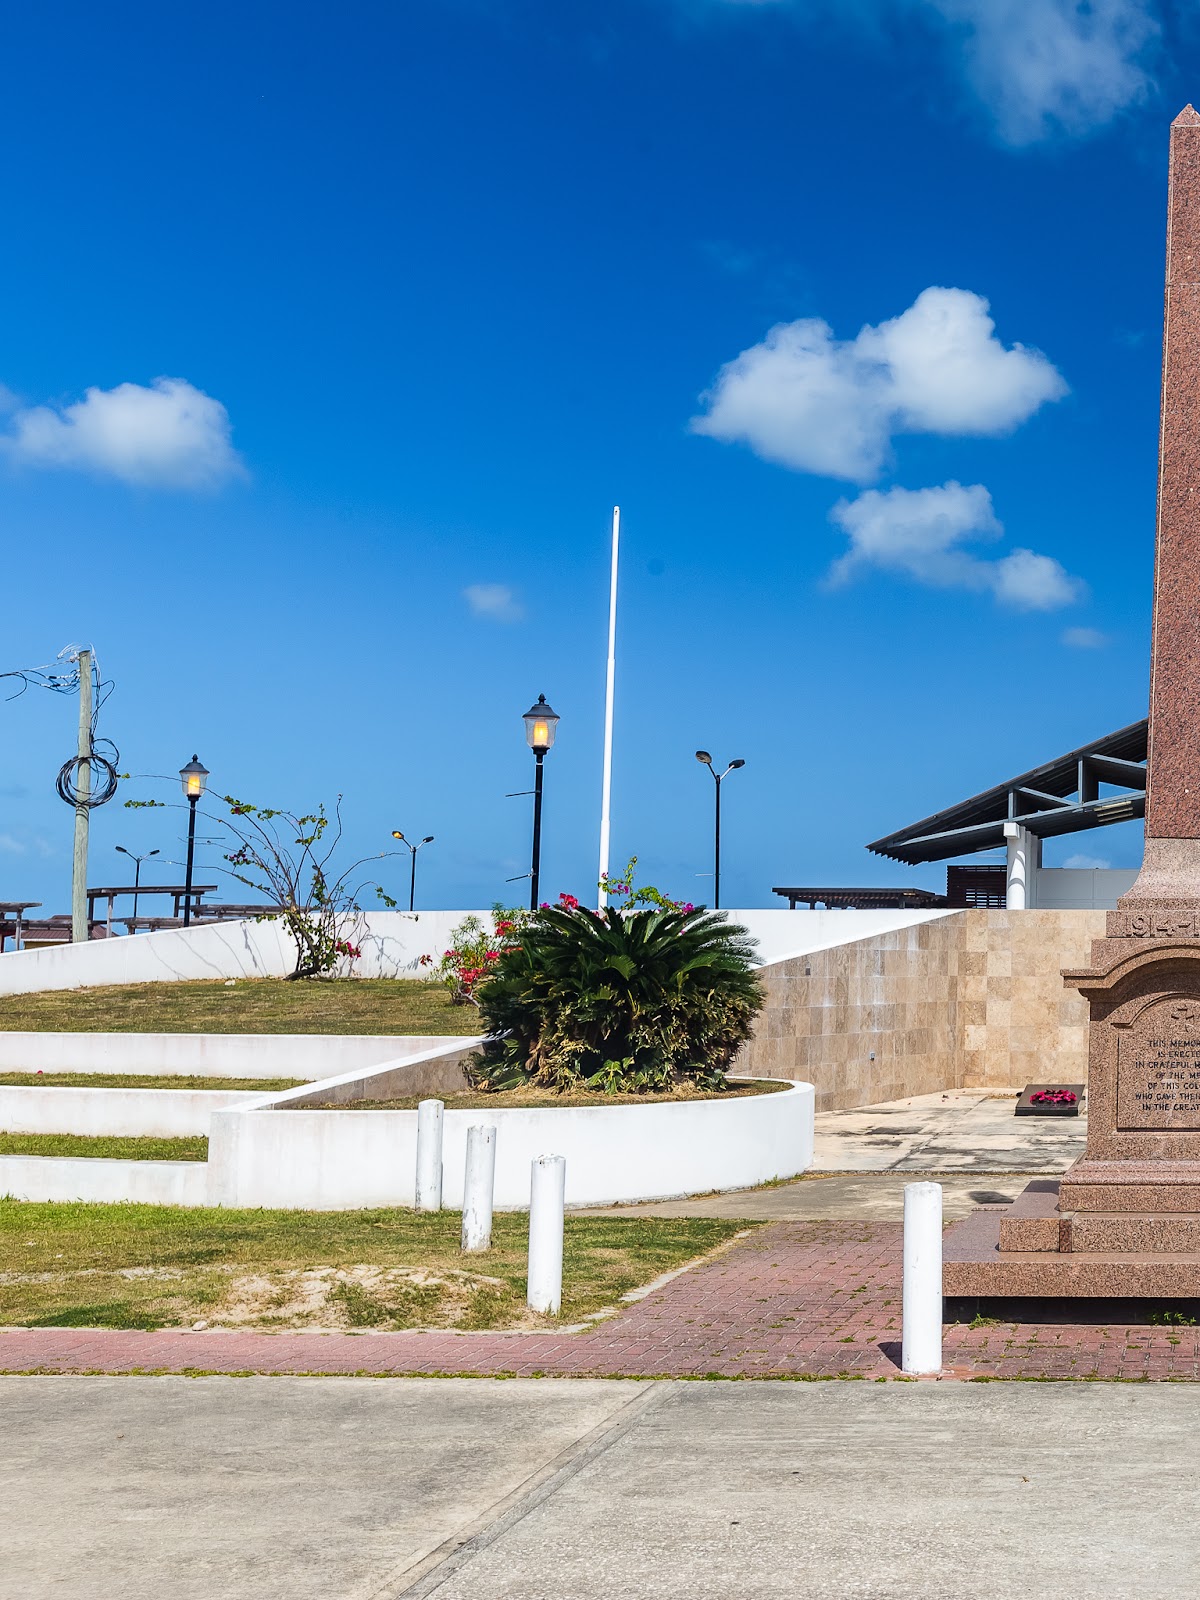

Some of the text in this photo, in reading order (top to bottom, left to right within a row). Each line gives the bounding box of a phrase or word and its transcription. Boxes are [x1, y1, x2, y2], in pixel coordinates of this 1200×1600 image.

[1148, 1039, 1166, 1048] THIS
[1157, 1050, 1166, 1058] IS
[1135, 1061, 1145, 1069] IN
[1148, 1061, 1191, 1069] GRATEFUL
[1147, 1082, 1158, 1090] OF
[1161, 1082, 1179, 1090] THIS
[1135, 1093, 1153, 1101] WHO
[1156, 1093, 1177, 1101] GAVE
[1142, 1103, 1151, 1111] IN
[1154, 1103, 1170, 1111] THE
[1173, 1103, 1200, 1111] GREAT
